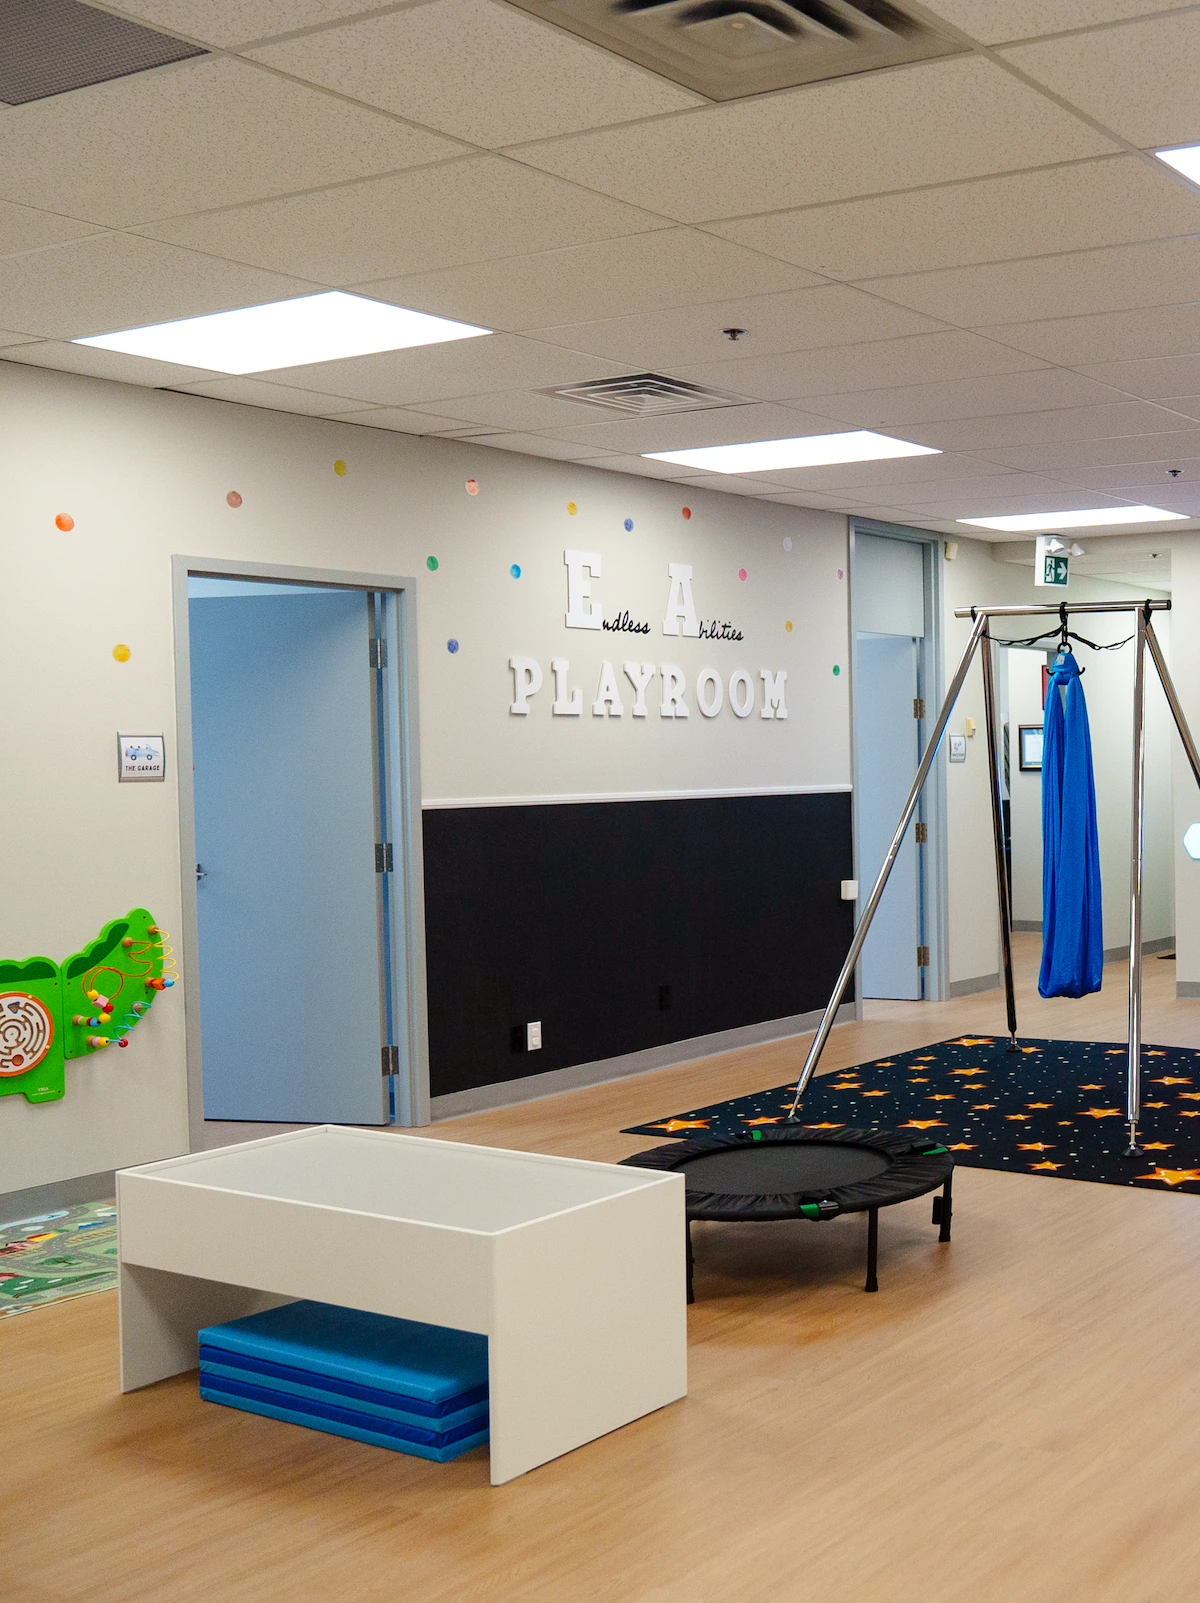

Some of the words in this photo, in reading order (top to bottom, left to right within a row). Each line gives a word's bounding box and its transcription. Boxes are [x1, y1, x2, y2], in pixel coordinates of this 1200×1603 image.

[564, 549, 651, 634] Endless
[662, 563, 744, 641] Abilities
[509, 656, 788, 719] PLAYROOM
